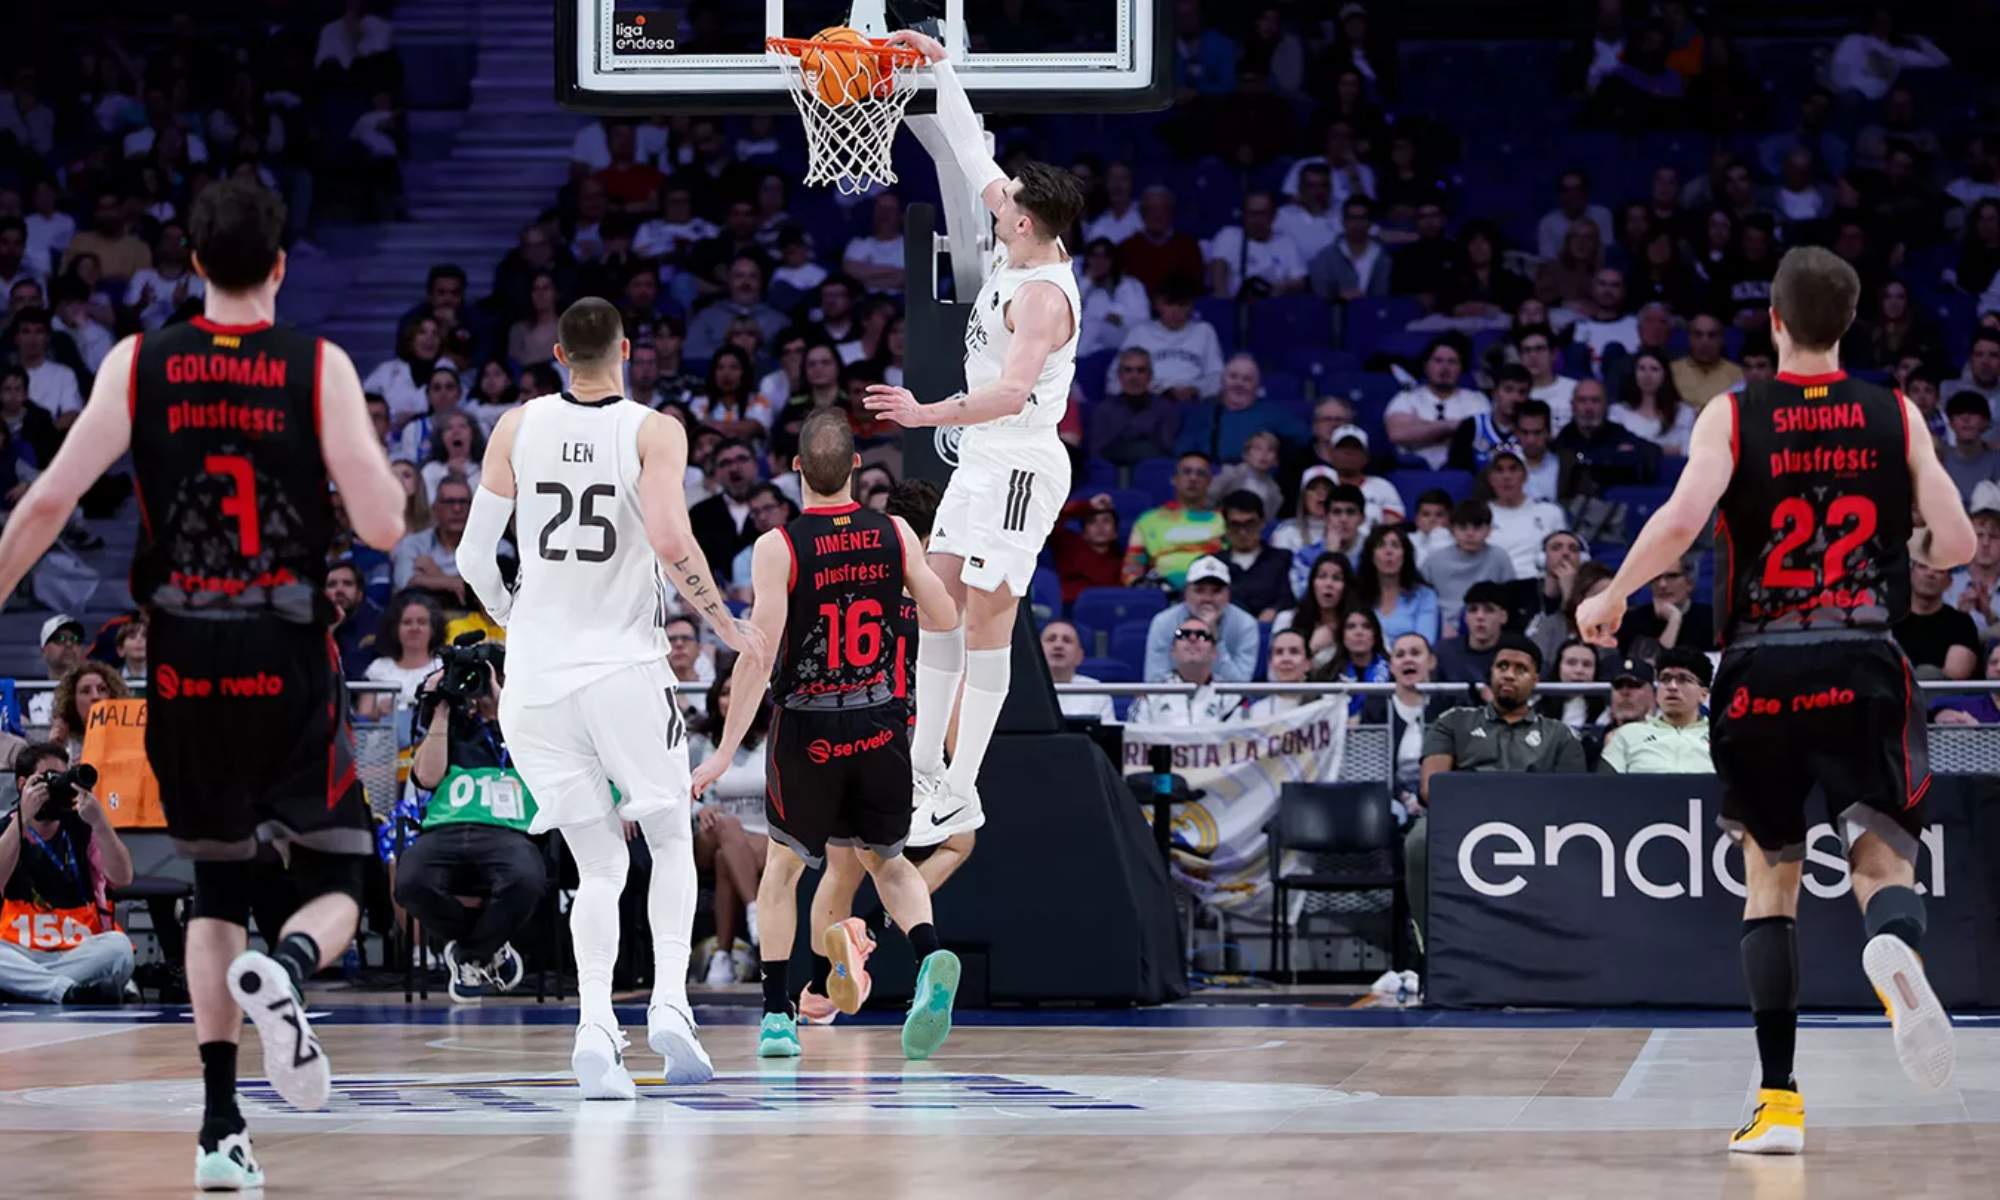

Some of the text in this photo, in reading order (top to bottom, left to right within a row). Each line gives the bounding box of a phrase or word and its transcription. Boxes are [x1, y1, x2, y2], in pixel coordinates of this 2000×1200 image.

[615, 22, 643, 38] liga
[615, 36, 675, 50] endesa
[165, 351, 287, 387] GOLOMÁN
[1772, 401, 1866, 433] SHURNA
[562, 442, 594, 463] LEN
[536, 481, 617, 563] 25
[814, 528, 882, 556] JIMÉNEZ
[1761, 494, 1878, 588] 22
[674, 556, 719, 615] LOVE
[819, 599, 883, 669] 16
[1229, 741, 1259, 764] LA
[1267, 720, 1331, 758] COMA
